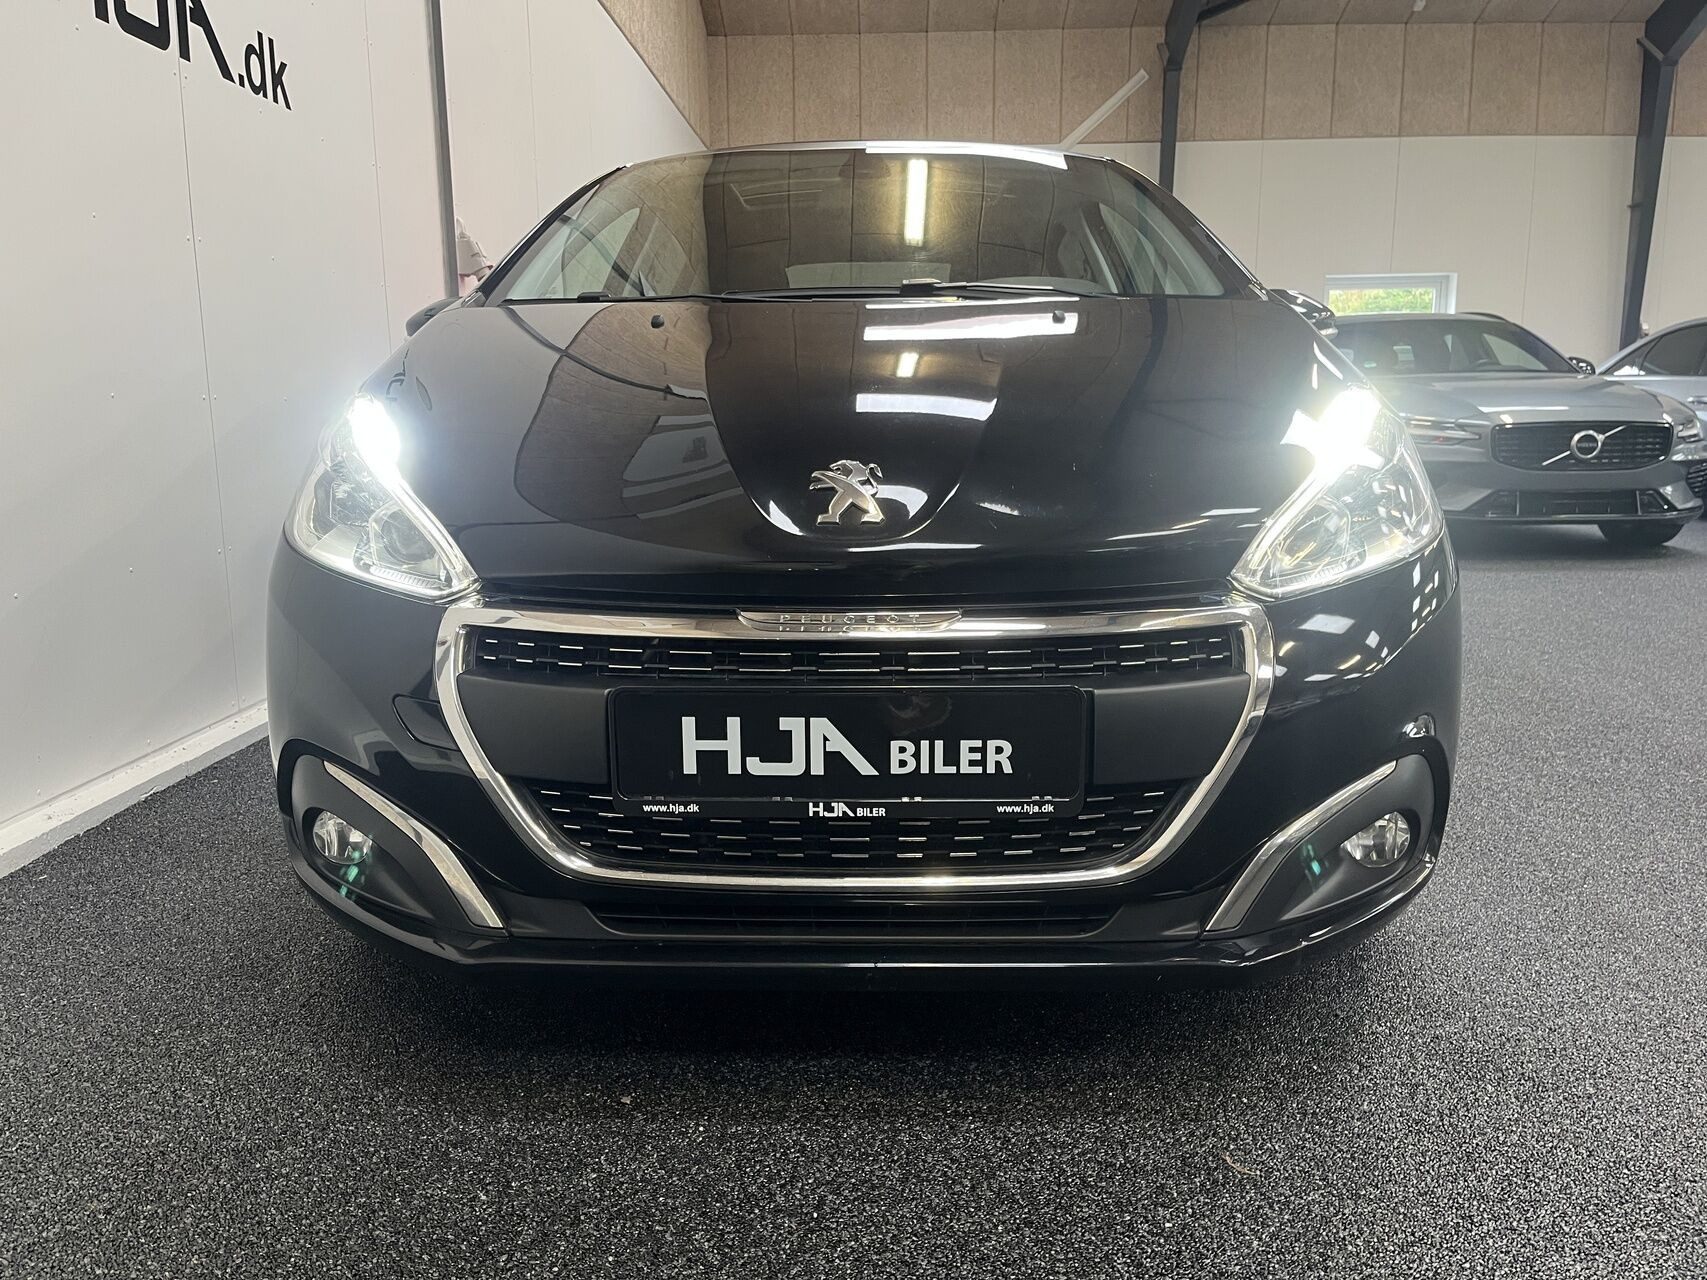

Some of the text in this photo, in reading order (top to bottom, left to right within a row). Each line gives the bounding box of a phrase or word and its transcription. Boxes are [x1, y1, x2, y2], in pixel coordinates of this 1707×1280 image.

[779, 614, 920, 624] PEUGEOT
[682, 716, 1013, 776] HJA BILER
[642, 803, 700, 815] www.hja.dk
[808, 803, 886, 817] HJA BILER
[996, 803, 1055, 815] www.hja.dk
